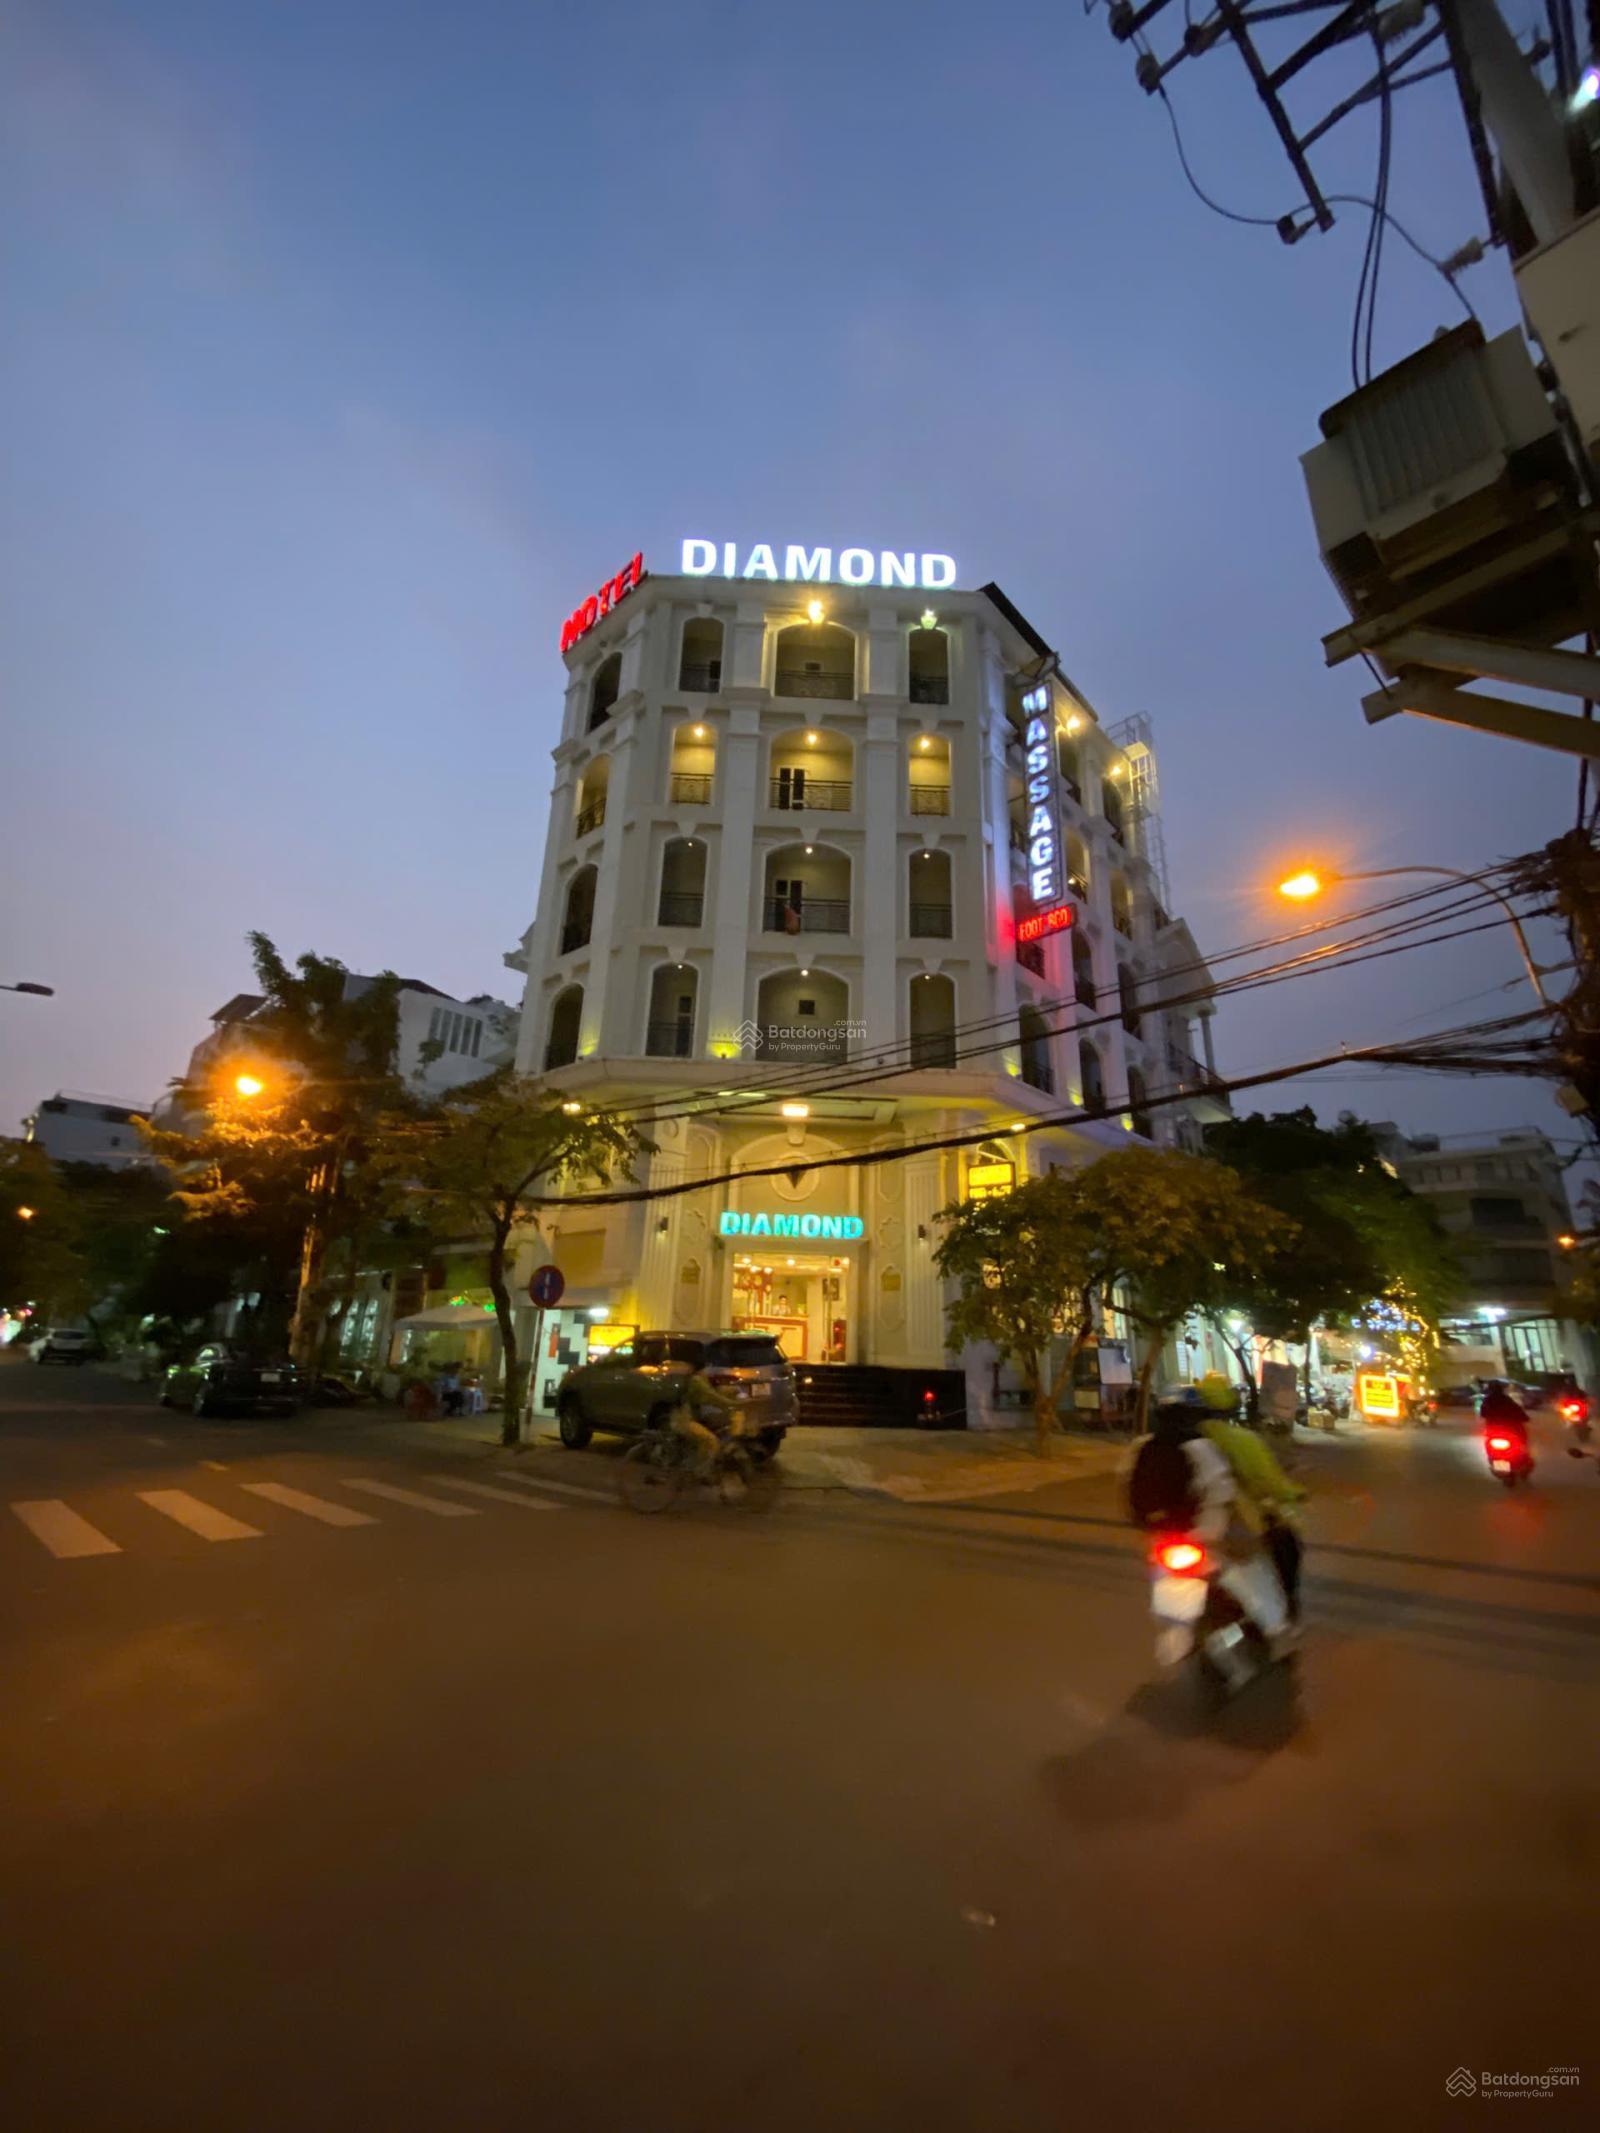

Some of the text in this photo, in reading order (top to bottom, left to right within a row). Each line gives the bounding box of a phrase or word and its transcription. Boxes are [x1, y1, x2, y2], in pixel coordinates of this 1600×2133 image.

[681, 538, 957, 590] DIAMOND
[1022, 686, 1054, 901] MASSAGE
[720, 1211, 864, 1239] DIAMOND
